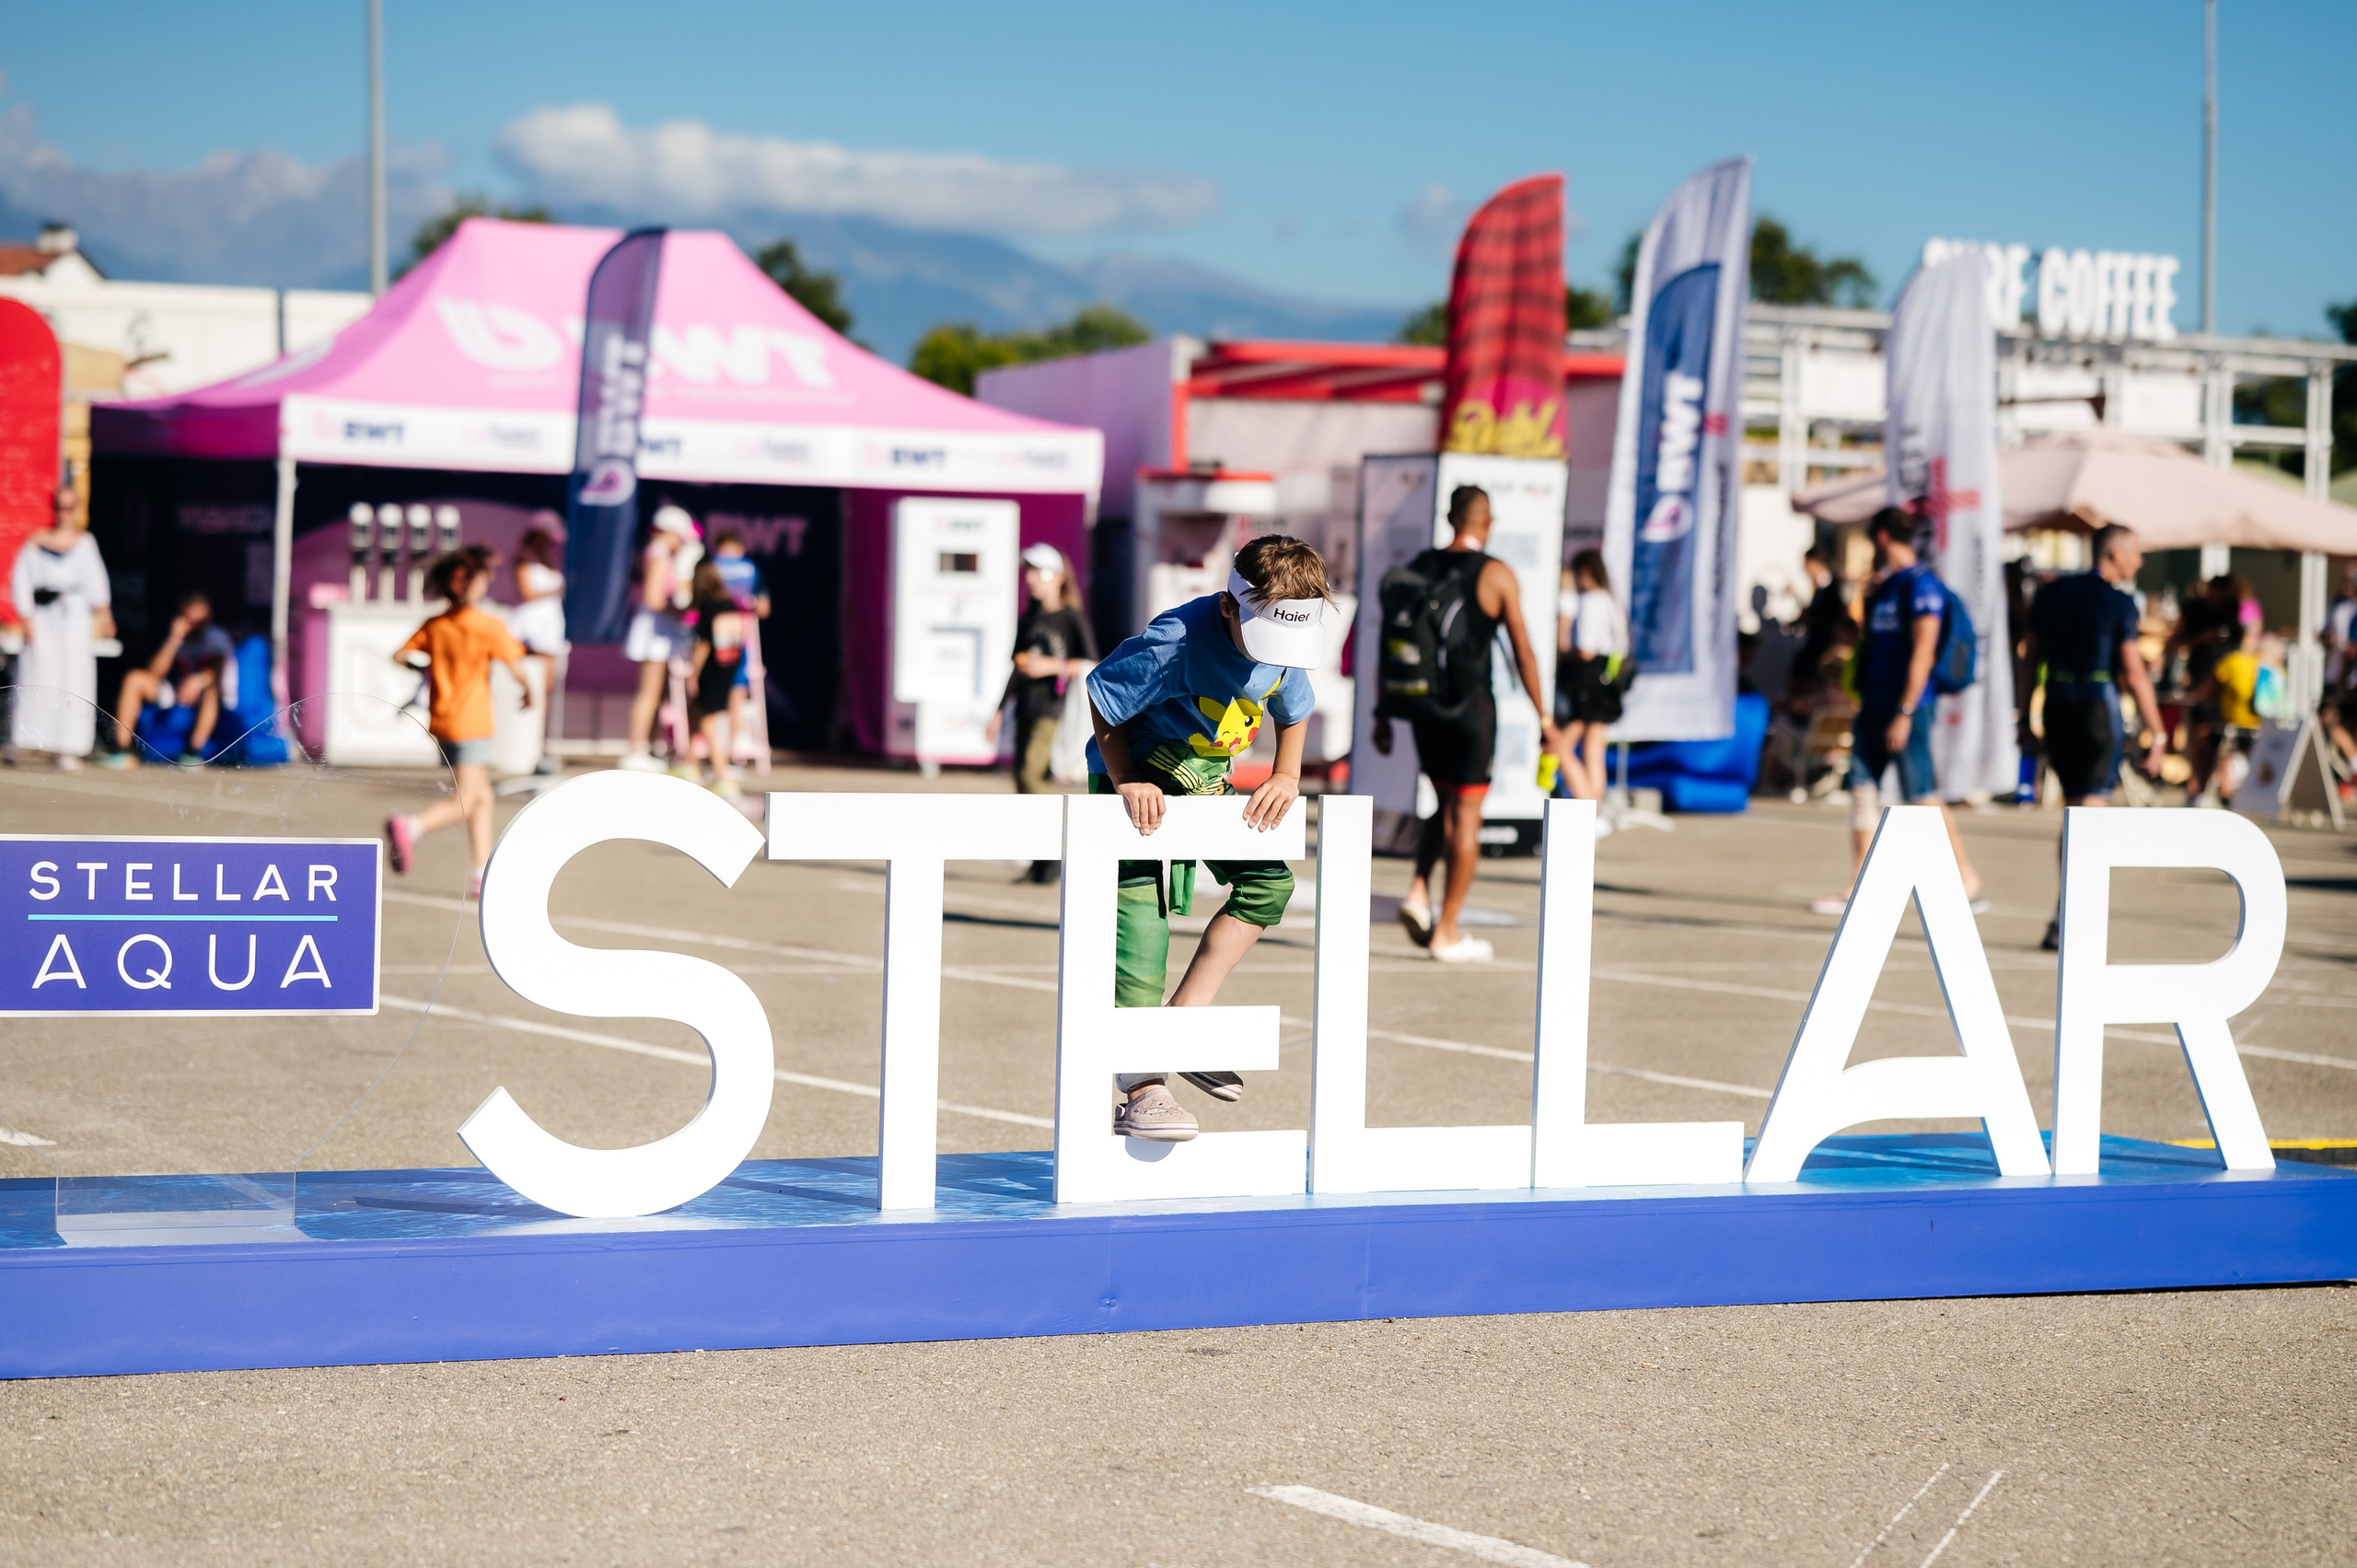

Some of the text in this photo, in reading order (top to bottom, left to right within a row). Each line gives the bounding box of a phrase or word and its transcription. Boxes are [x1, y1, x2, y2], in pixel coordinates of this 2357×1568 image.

[2038, 246, 2179, 342] COFFEE
[1656, 370, 1703, 493] BWT
[1273, 608, 1310, 622] Haier
[29, 860, 339, 901] STELLAR
[31, 933, 332, 992] AQUA
[457, 770, 2286, 1217] STELLAR
